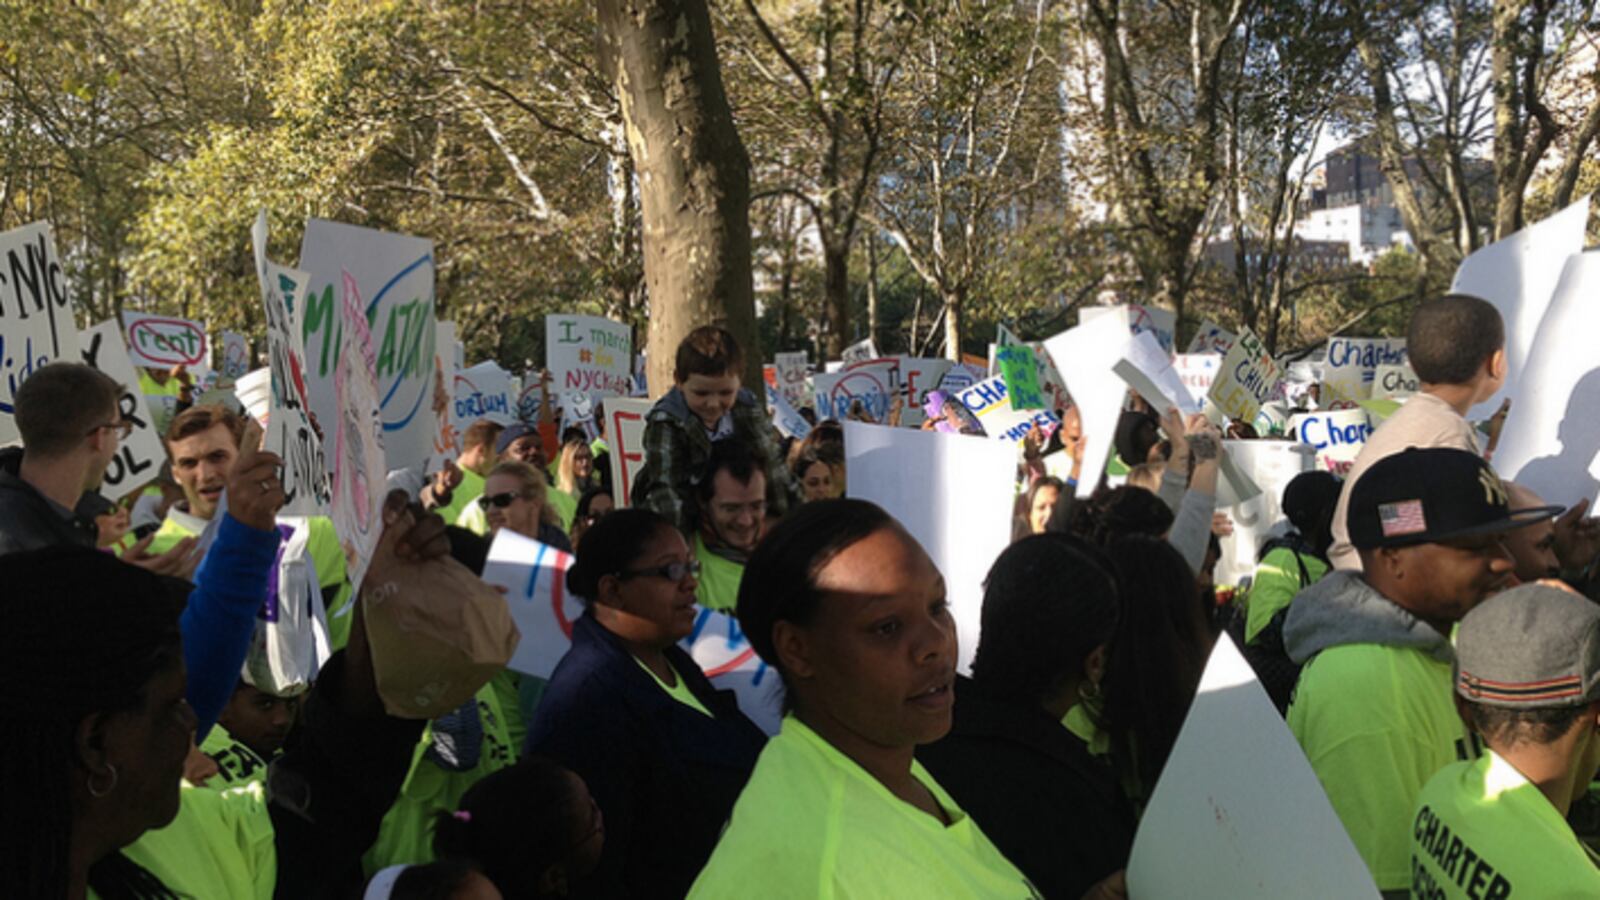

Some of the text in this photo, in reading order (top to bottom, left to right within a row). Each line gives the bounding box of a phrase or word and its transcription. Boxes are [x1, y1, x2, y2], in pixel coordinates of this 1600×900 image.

[138, 328, 200, 355] rent
[558, 321, 631, 352] I march
[1414, 805, 1512, 900] CHARTER
